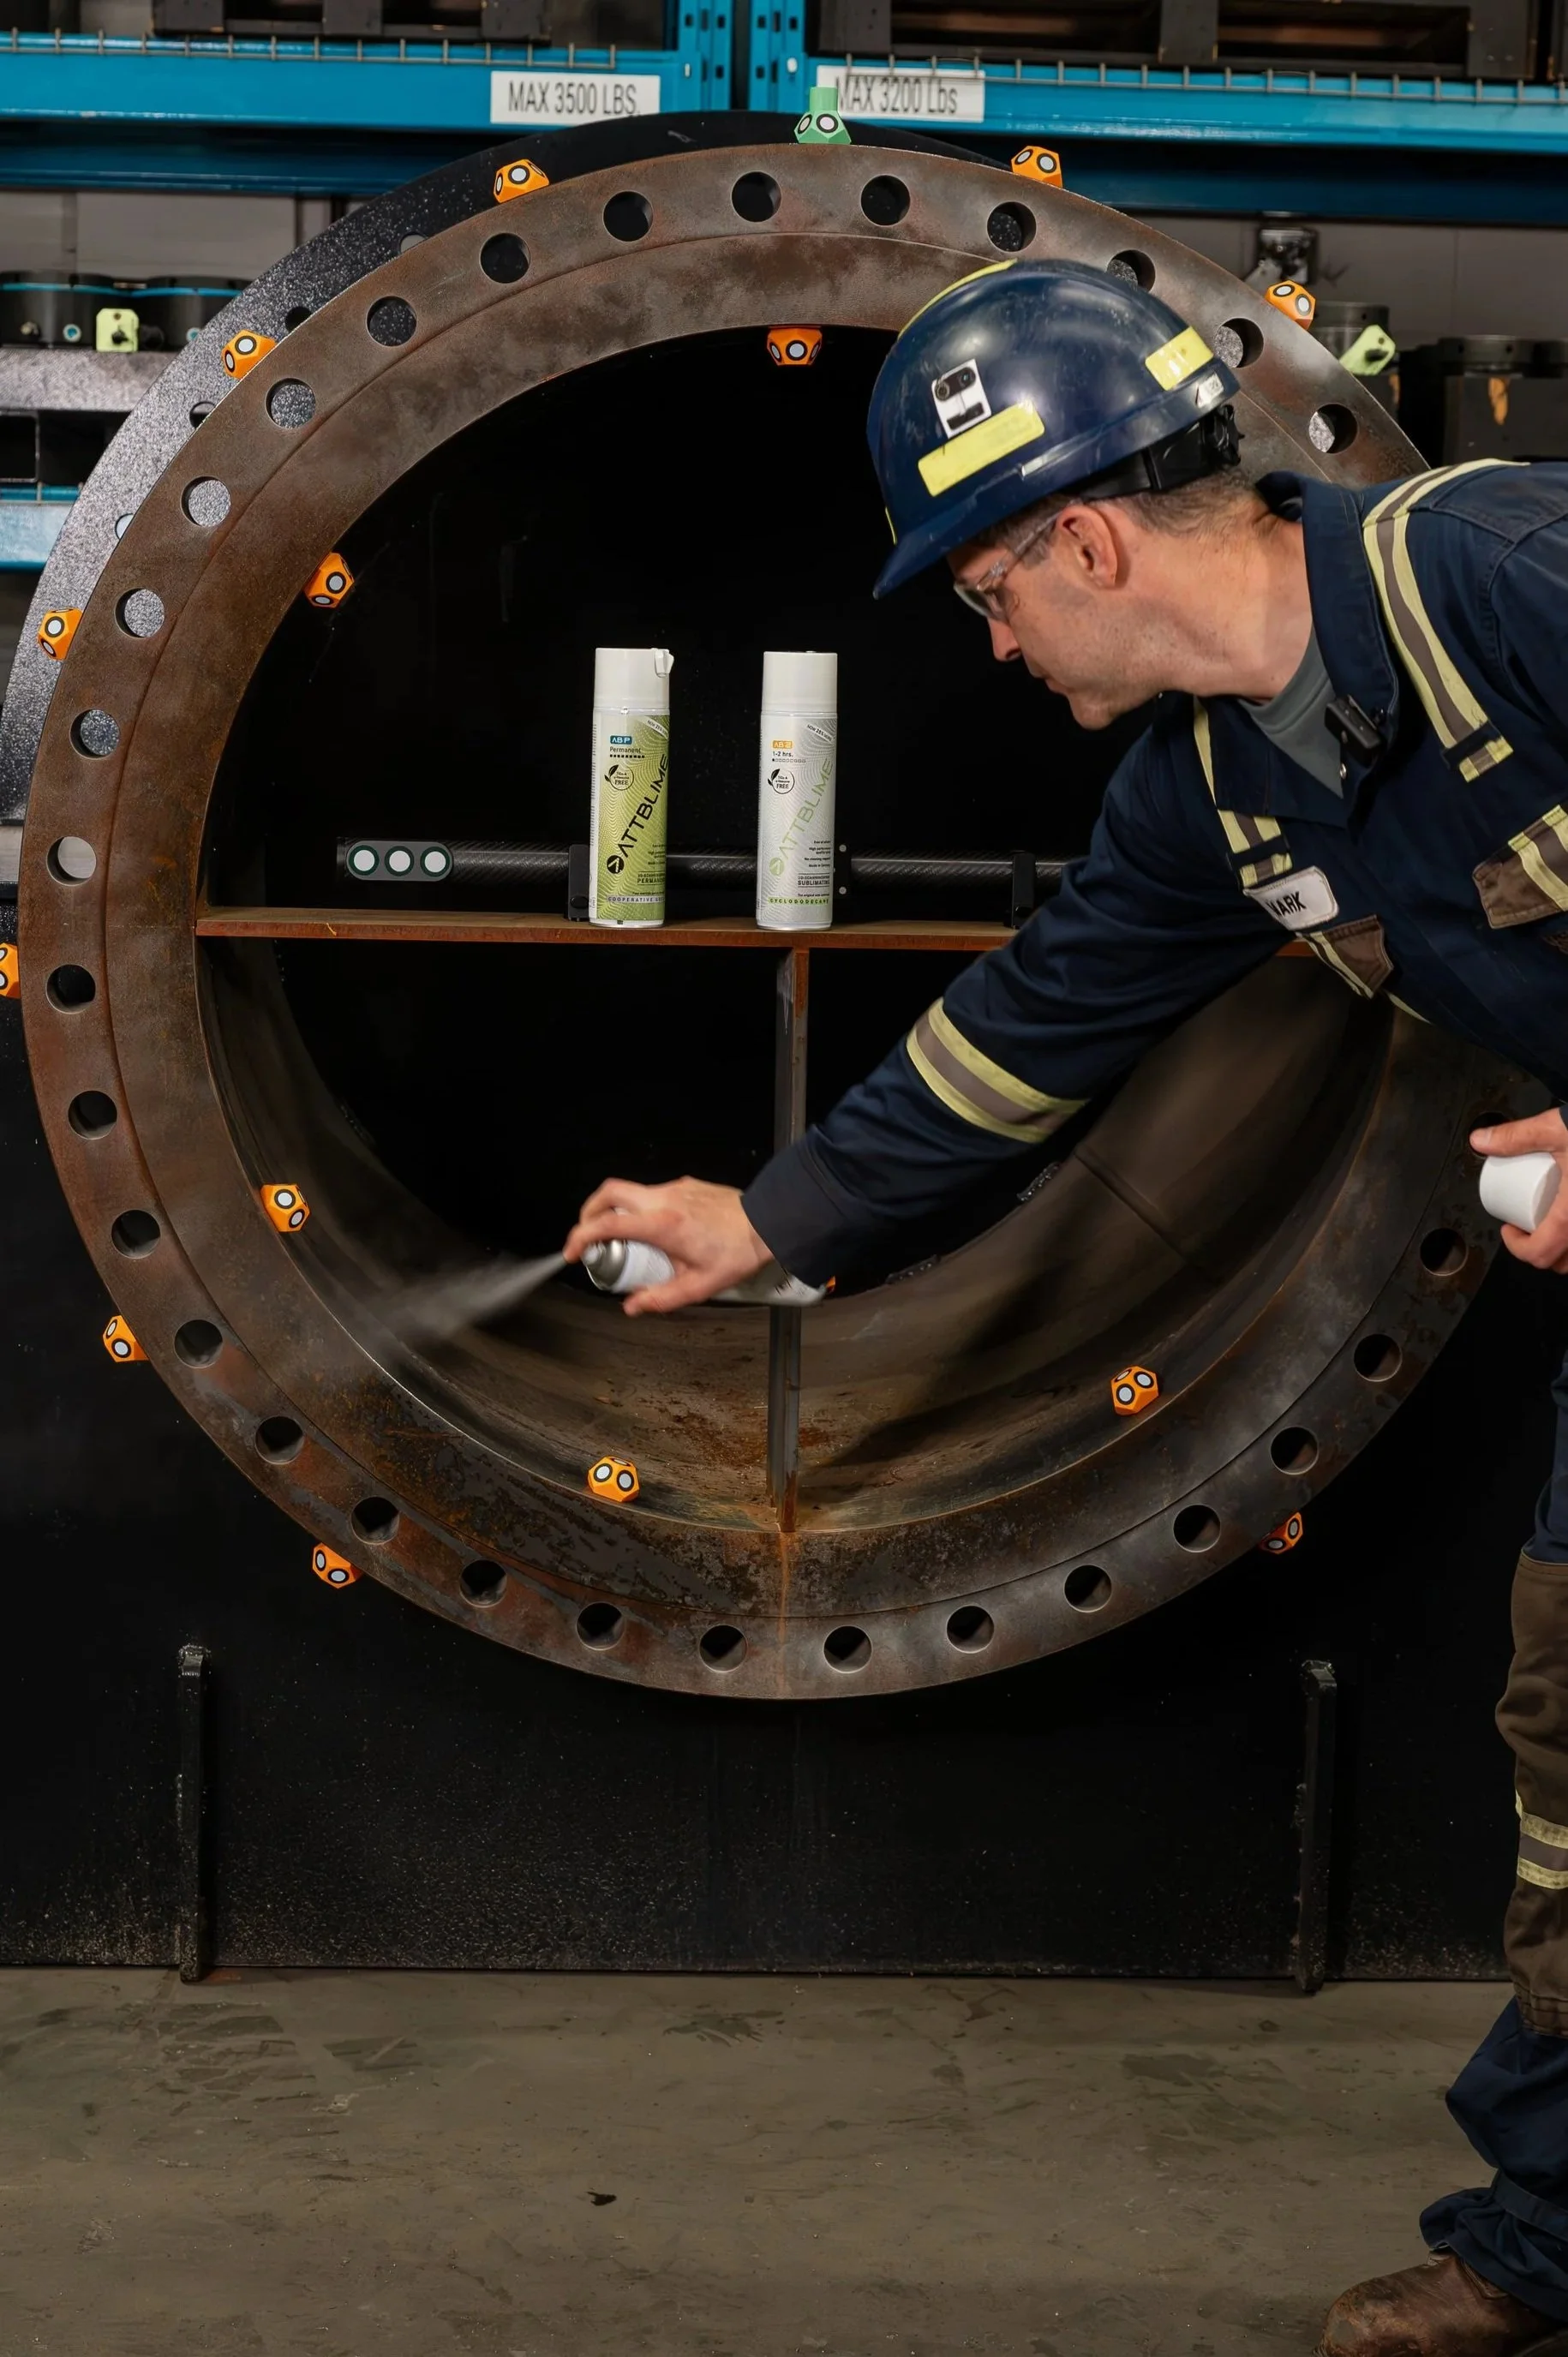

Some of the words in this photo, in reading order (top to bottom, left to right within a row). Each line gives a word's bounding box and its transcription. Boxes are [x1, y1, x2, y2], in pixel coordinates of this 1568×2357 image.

[508, 81, 549, 112] MAX
[554, 82, 597, 114] 3500
[835, 75, 875, 112] MAX
[880, 76, 922, 113] 3200
[928, 77, 958, 114] Lbs
